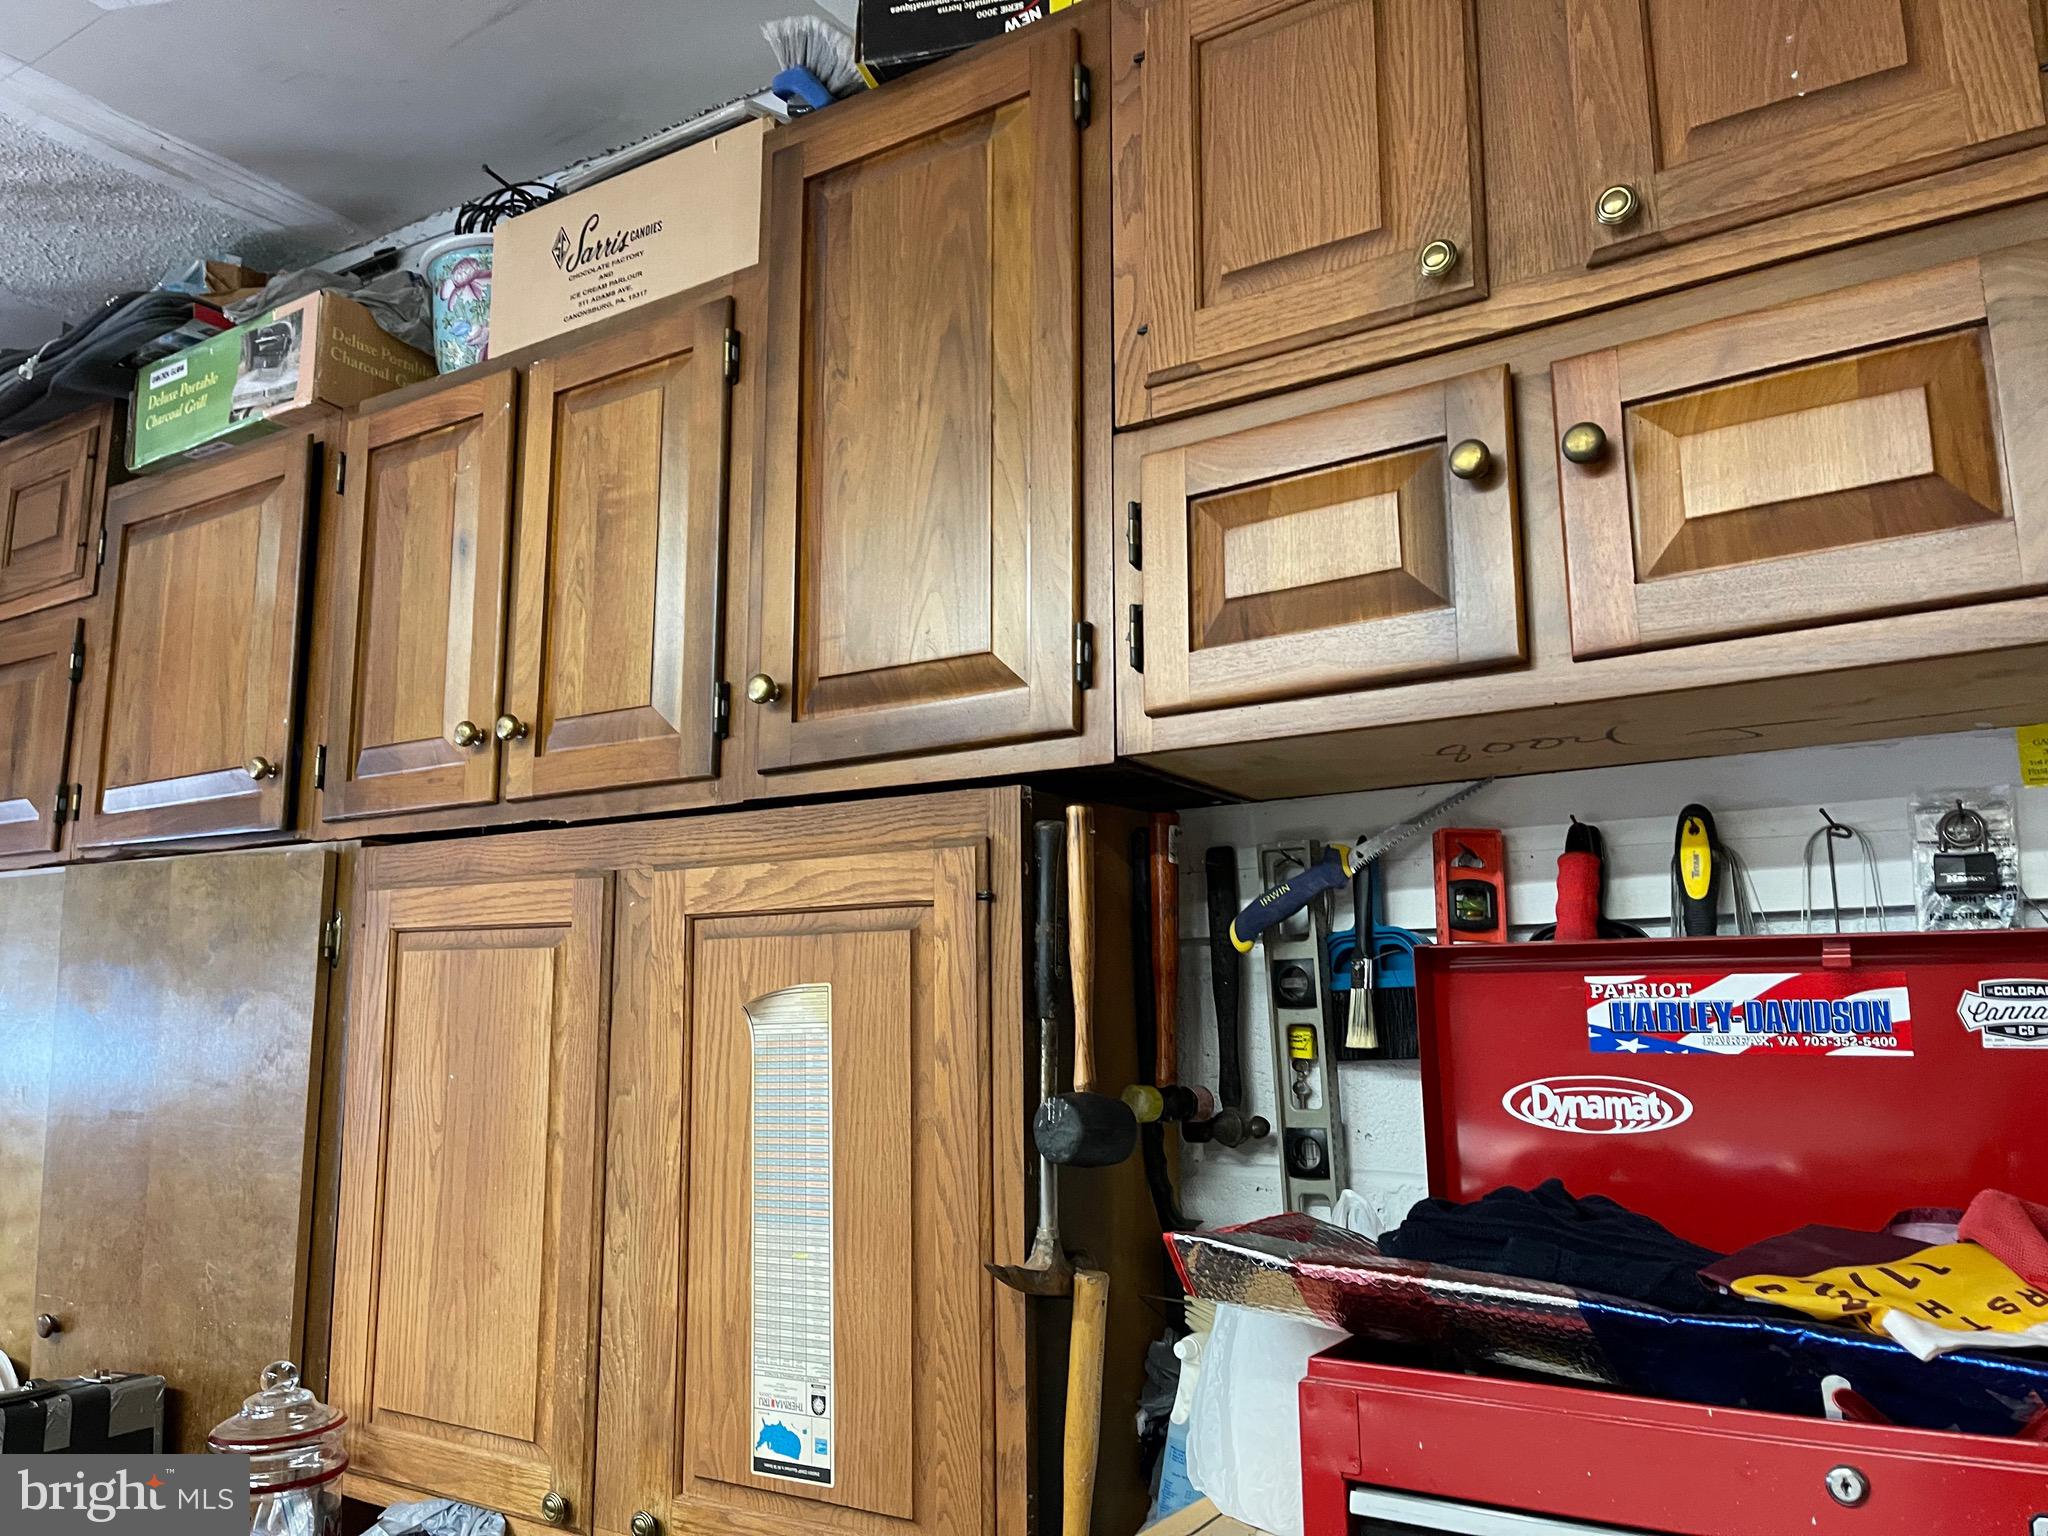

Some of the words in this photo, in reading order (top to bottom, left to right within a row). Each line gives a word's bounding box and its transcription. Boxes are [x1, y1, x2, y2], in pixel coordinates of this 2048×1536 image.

[976, 8, 998, 19] 3000
[1005, 6, 1042, 33] NEW
[566, 213, 629, 272] Sarris
[630, 220, 663, 242] CANDIES
[568, 261, 610, 281] CHOCOLATE
[611, 250, 645, 268] FACTORY
[598, 270, 614, 281] AND
[570, 290, 581, 300] ICE
[582, 281, 608, 296] CREAM
[609, 270, 643, 287] PARLOUR
[591, 290, 616, 303] ADAMS
[332, 326, 378, 357] Deluxe
[330, 346, 390, 381] Charcoal
[148, 390, 178, 411] Deluxe
[180, 371, 219, 397] Portable
[145, 403, 184, 431] Charcoal
[184, 393, 208, 414] Grill
[1259, 883, 1291, 908] IRWIN
[1589, 983, 1692, 999] PATRIOT
[1609, 999, 1894, 1035] HARLEY-DAVIDSON
[1703, 1035, 1774, 1048] FAIRFAX,
[1777, 1036, 1800, 1047] VA
[1803, 1036, 1897, 1047] 703-352-5400
[1531, 1084, 1662, 1127] Dynamat
